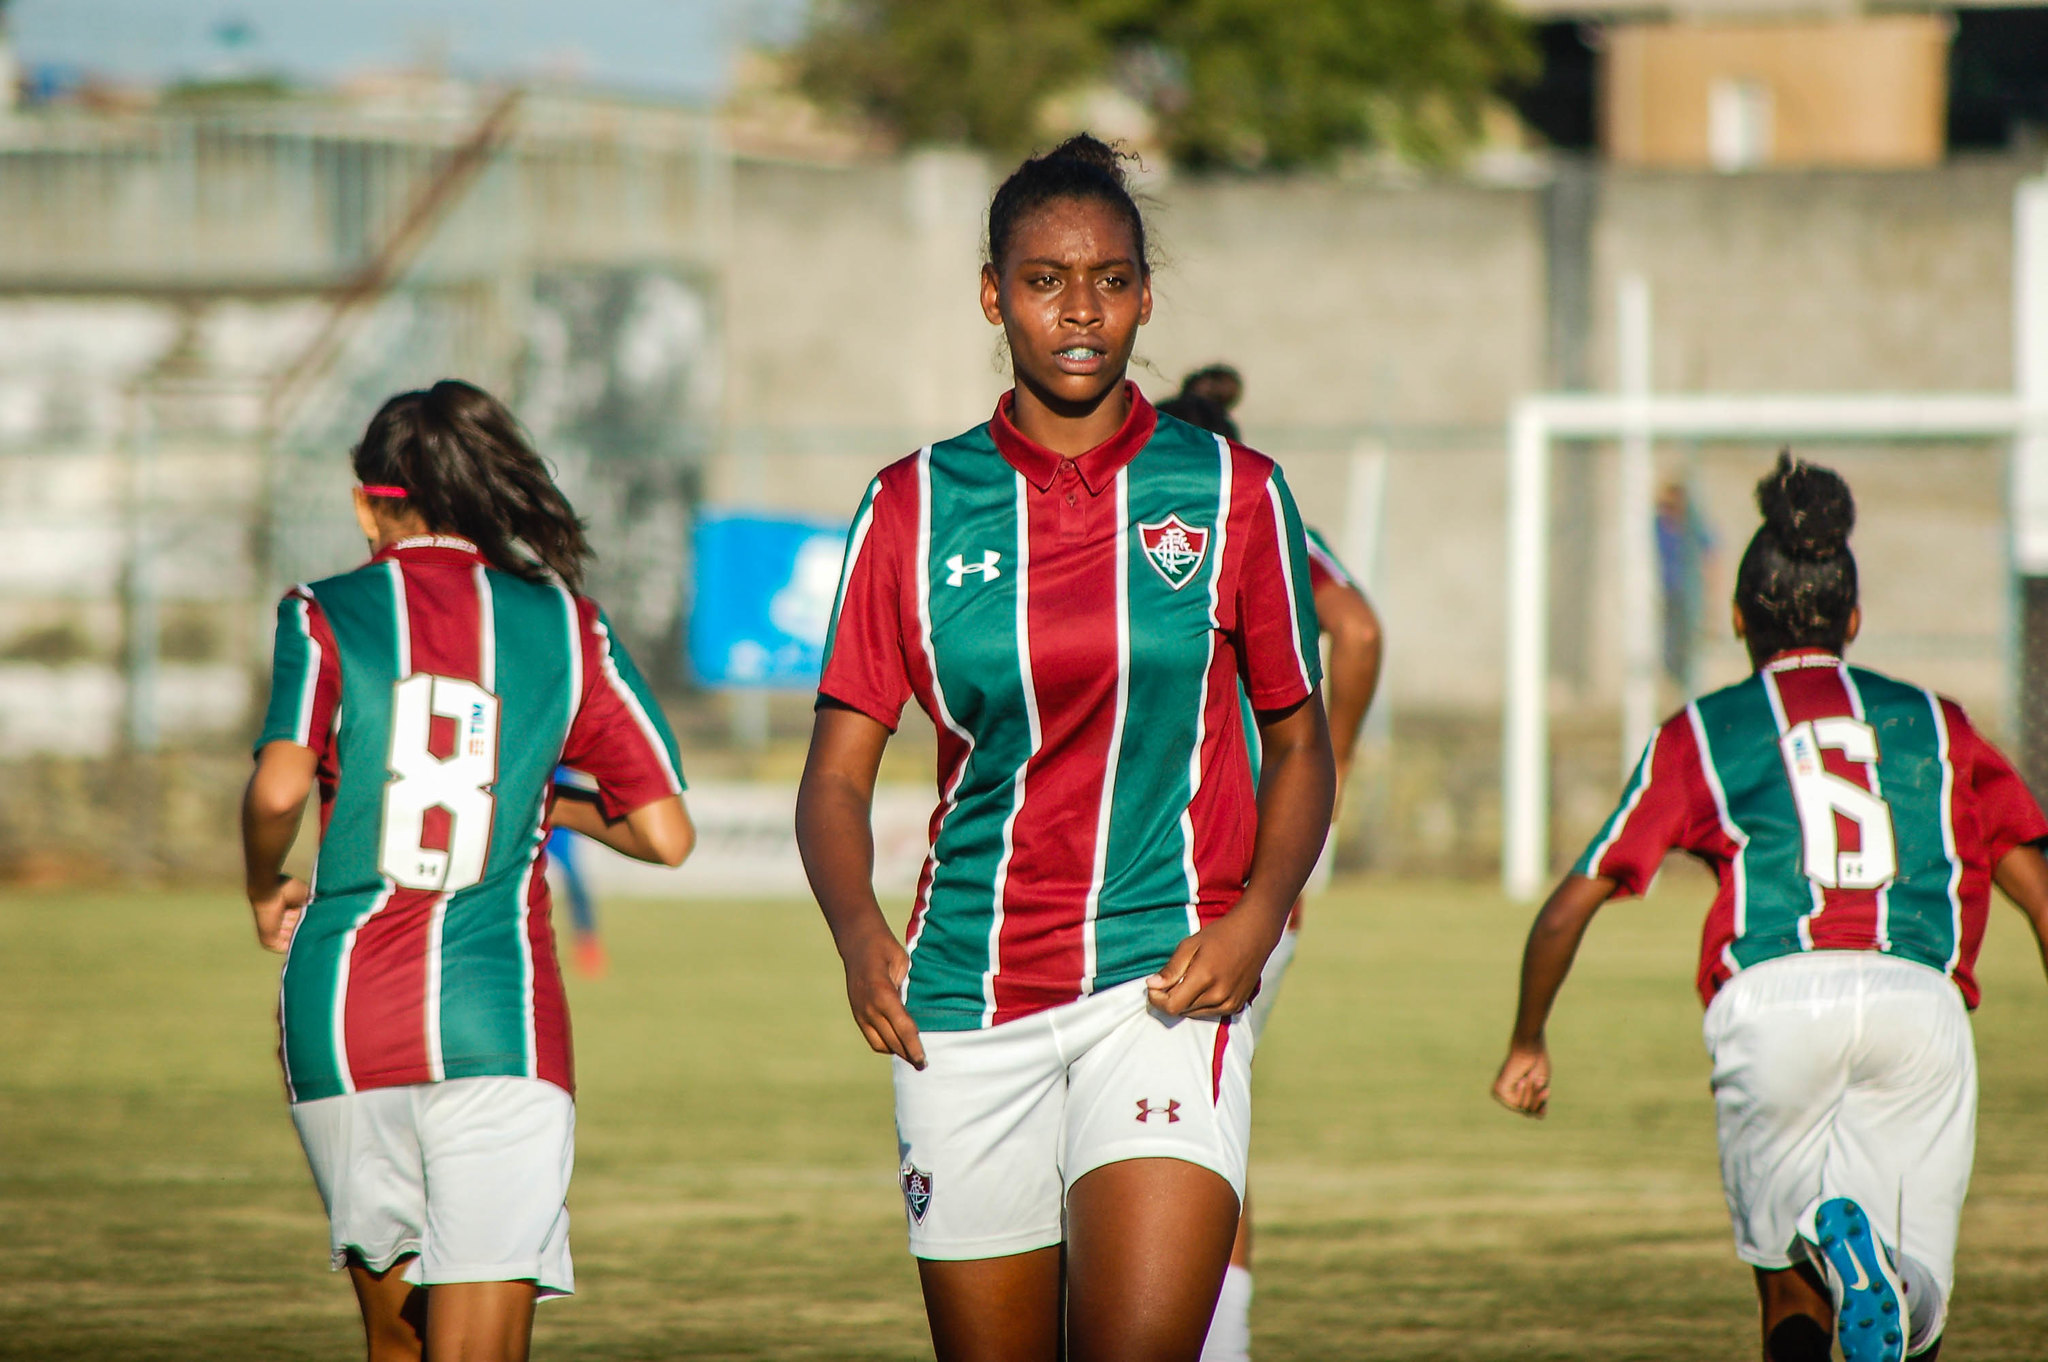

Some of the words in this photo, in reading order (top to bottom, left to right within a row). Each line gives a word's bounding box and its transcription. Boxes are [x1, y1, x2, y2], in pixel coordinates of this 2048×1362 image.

[379, 672, 501, 891] 8
[470, 702, 485, 734] TIM
[1780, 716, 1898, 889] 6
